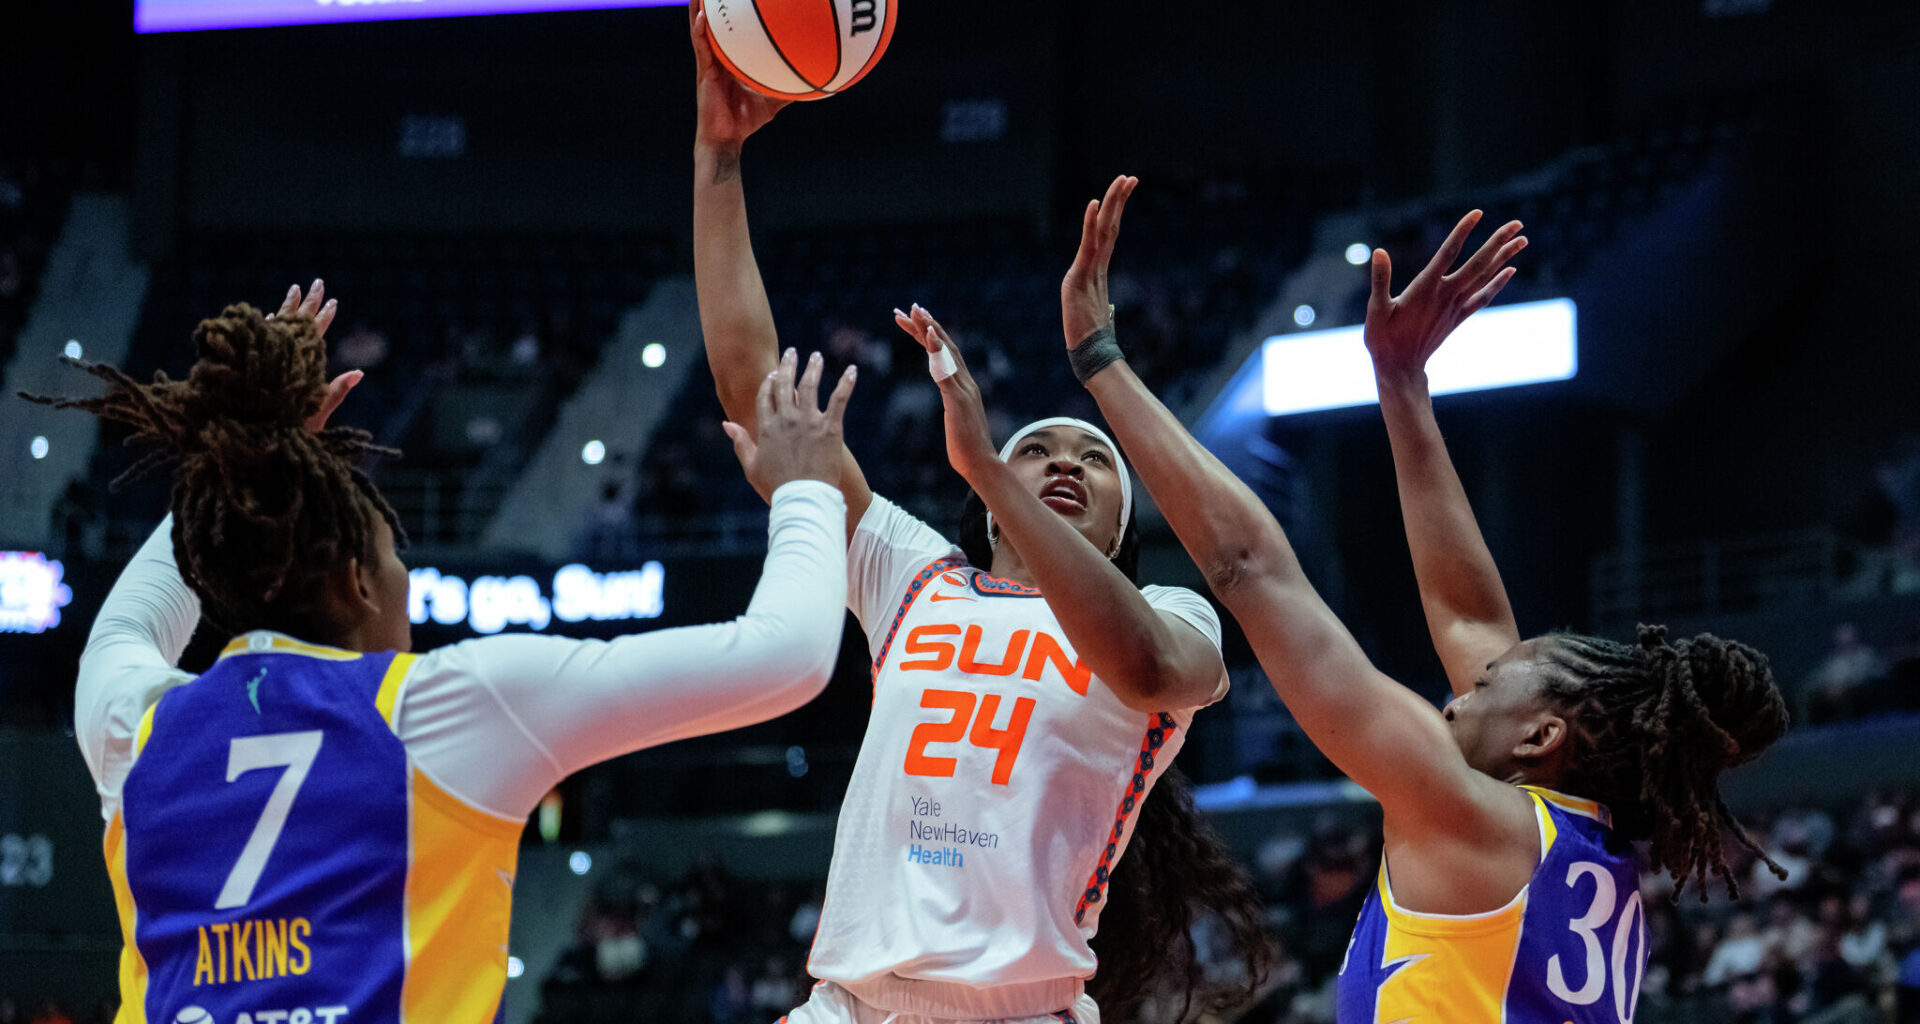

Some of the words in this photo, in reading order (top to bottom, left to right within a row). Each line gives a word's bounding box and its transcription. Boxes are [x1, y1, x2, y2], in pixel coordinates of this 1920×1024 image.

[469, 575, 551, 634] go,
[552, 561, 664, 622] Sun!
[899, 623, 1092, 697] SUN
[904, 688, 1037, 786] 24
[214, 730, 324, 910] 7
[910, 820, 999, 848] NewHaven
[911, 796, 941, 817] Yale
[908, 843, 964, 868] Health
[193, 917, 312, 986] ATKINS
[1546, 861, 1645, 1024] 30
